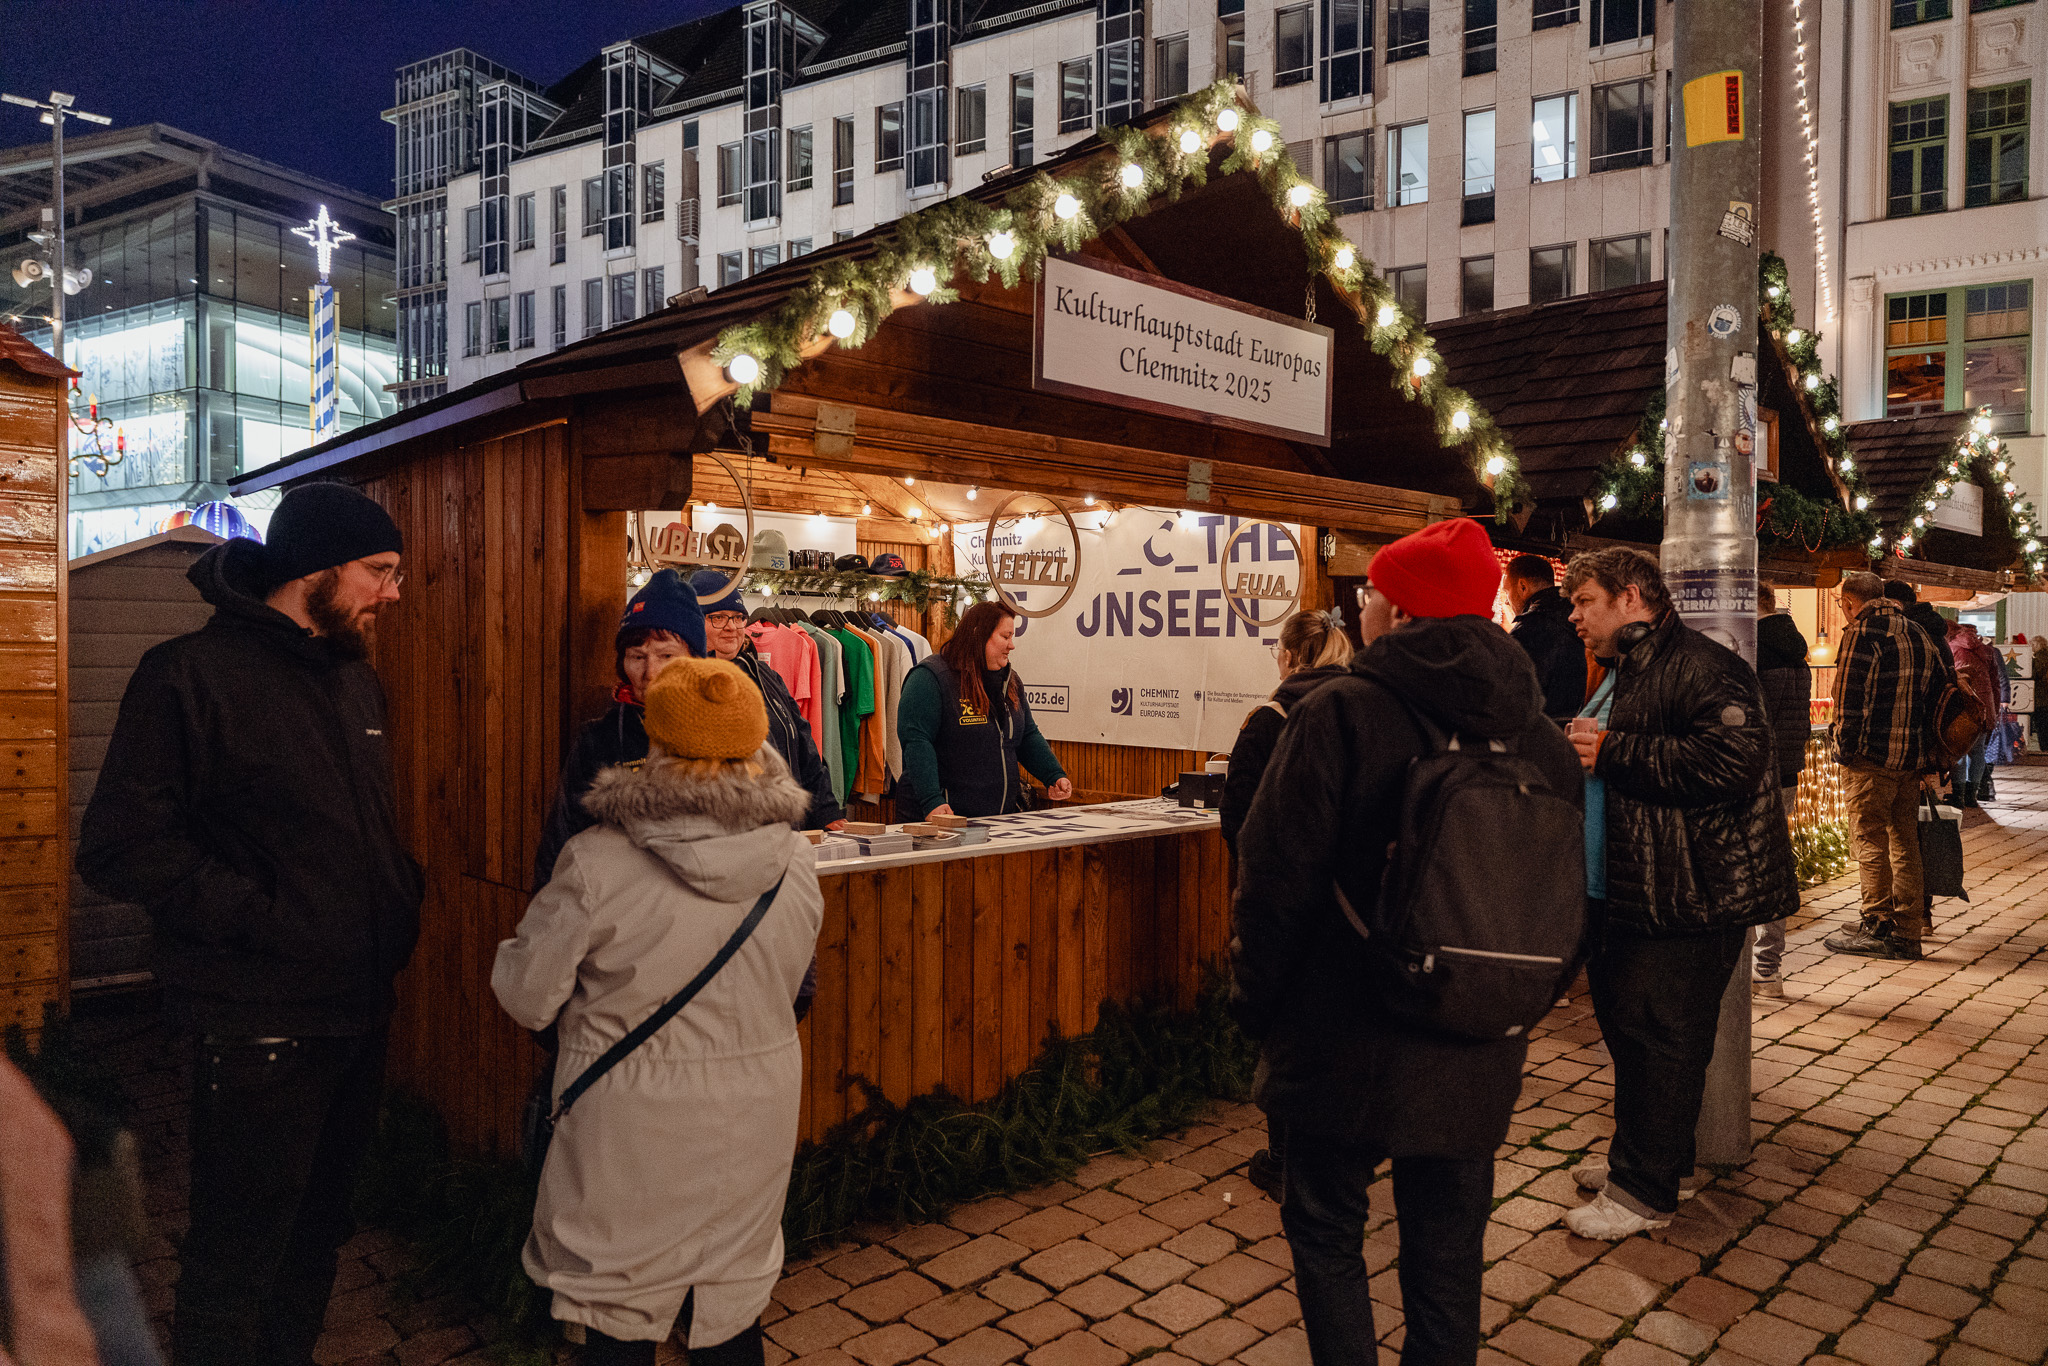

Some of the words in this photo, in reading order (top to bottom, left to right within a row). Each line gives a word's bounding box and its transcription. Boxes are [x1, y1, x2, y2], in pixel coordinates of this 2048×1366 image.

[1054, 285, 1244, 358] Kulturhauptstadt
[1249, 338, 1321, 382] Europas
[1119, 346, 1220, 393] Chemnitz
[1224, 372, 1273, 404] 2025
[970, 532, 1023, 549] Chmnitz
[1236, 573, 1293, 597] EUJA.
[1140, 688, 1179, 699] CHEMNITZ
[1140, 709, 1166, 718] EUROPAS
[1166, 710, 1180, 719] 2025
